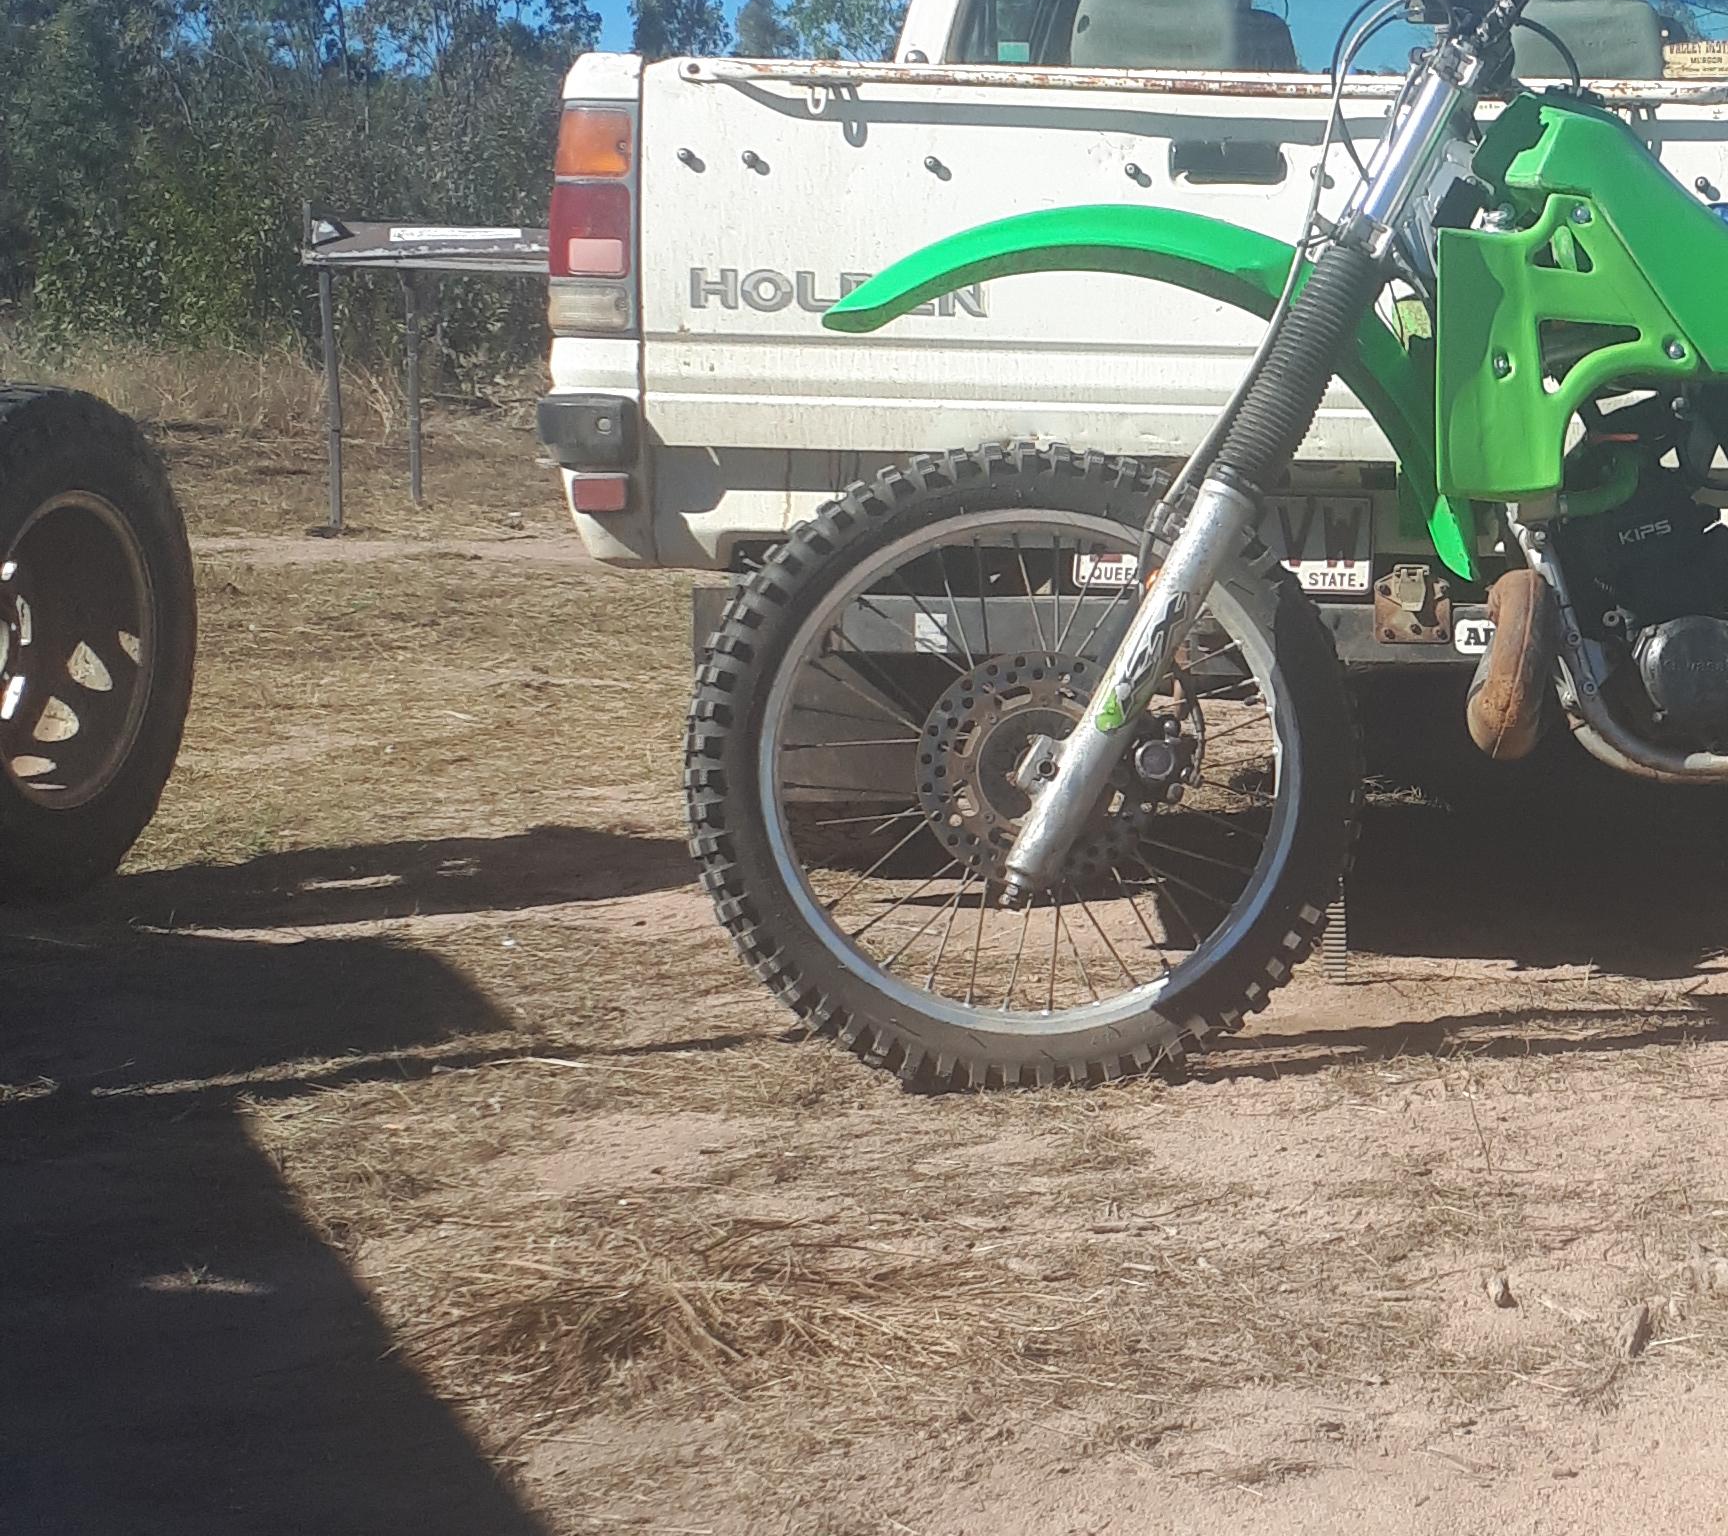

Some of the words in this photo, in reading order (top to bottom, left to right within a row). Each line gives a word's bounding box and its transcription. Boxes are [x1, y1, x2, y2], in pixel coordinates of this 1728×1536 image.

[689, 266, 988, 318] HOLN
[1618, 519, 1672, 545] KIPS
[1308, 572, 1357, 588] STATE
